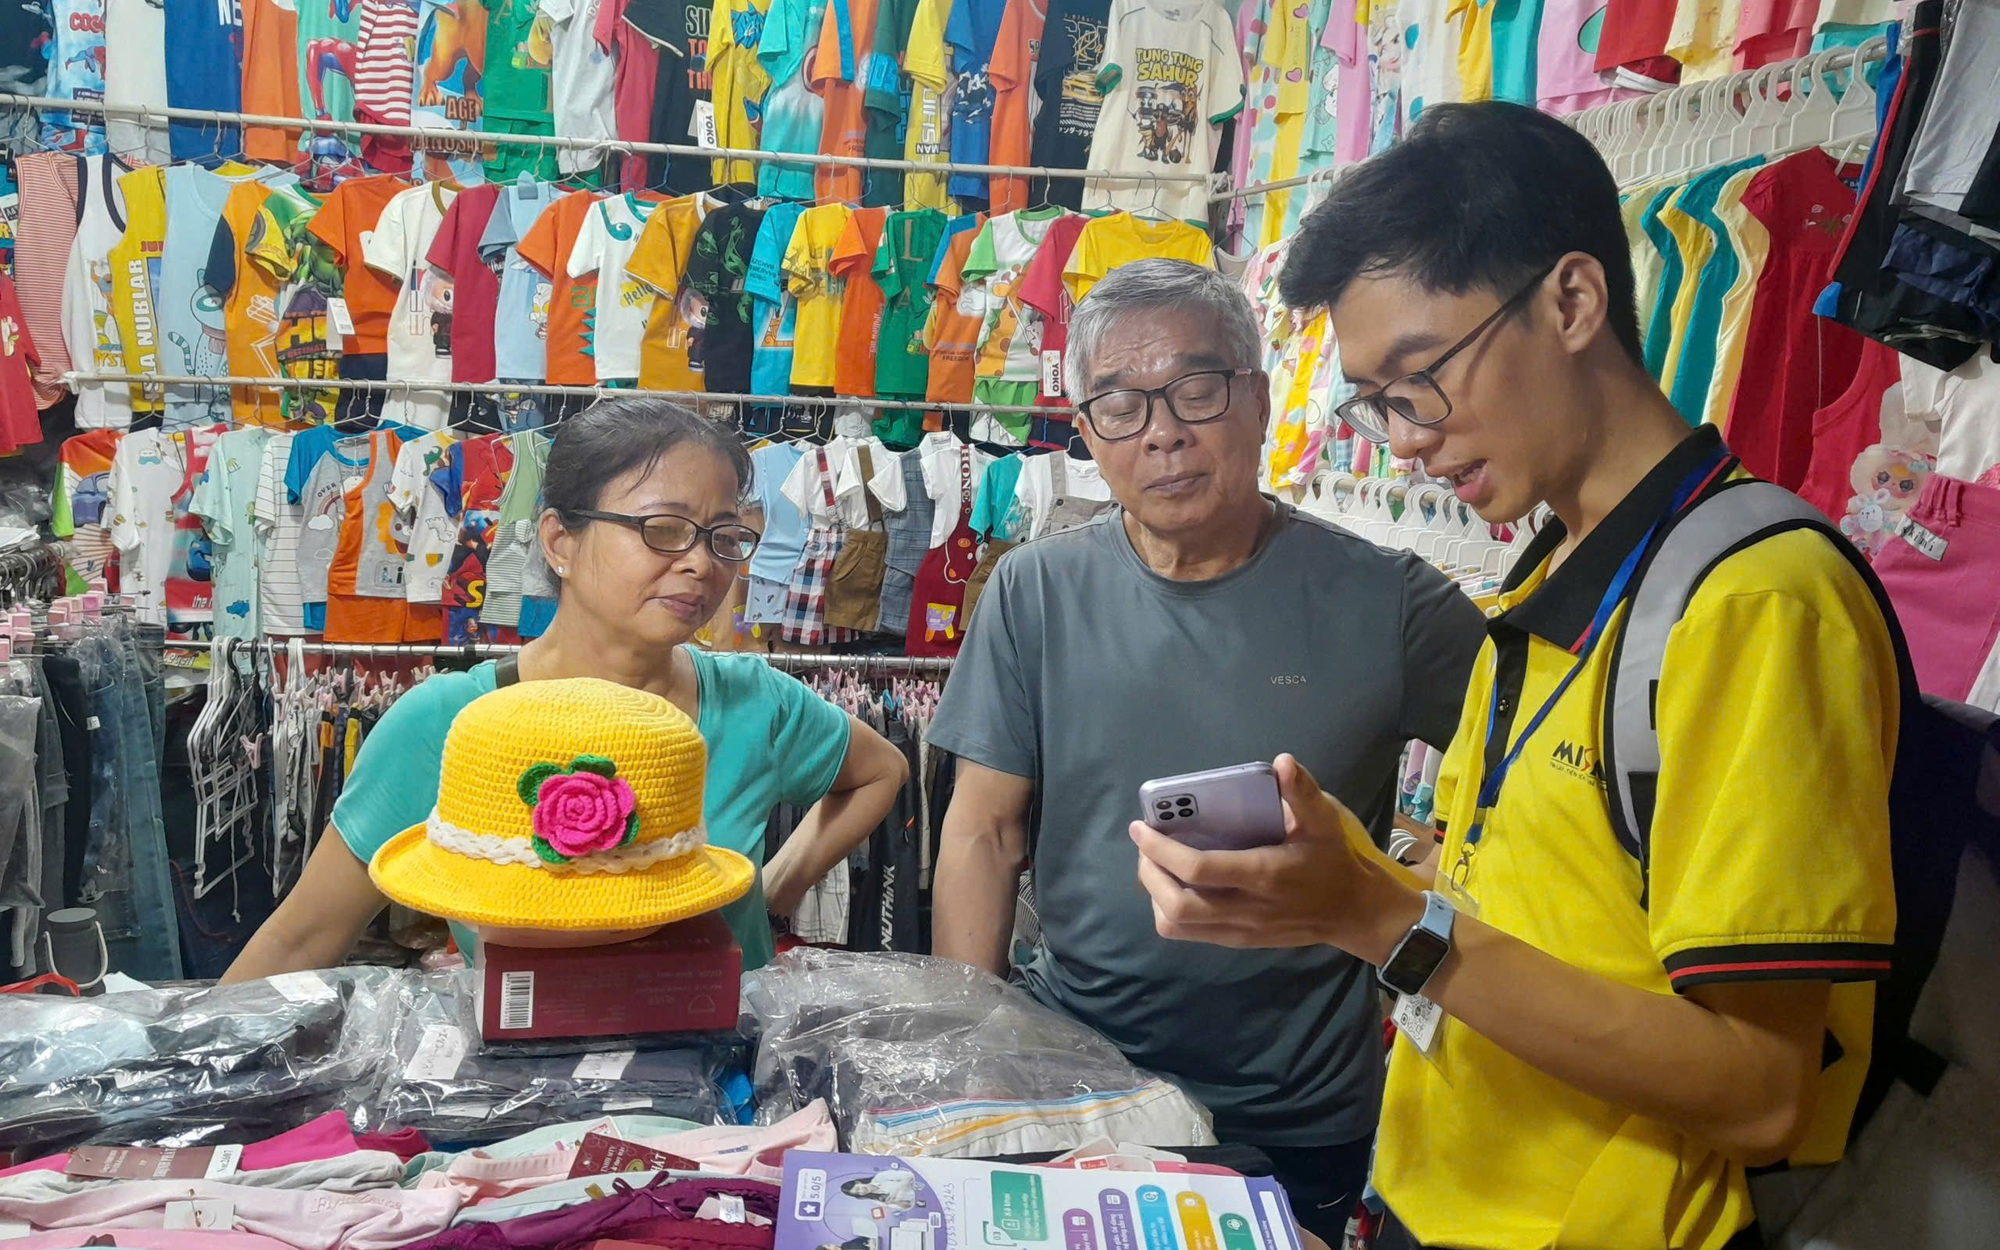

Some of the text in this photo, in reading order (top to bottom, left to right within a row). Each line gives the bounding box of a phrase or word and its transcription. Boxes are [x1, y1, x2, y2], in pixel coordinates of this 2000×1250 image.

[1135, 47, 1204, 72] TUNG TUNG
[1136, 61, 1200, 88] SAHUR
[445, 95, 477, 122] AGE
[705, 114, 715, 146] YOKO
[916, 144, 940, 154] MAN
[128, 258, 154, 347] NUBLAR
[1051, 363, 1059, 393] YOKO
[317, 482, 336, 498] OVER
[1270, 675, 1307, 685] VESCA
[810, 1175, 822, 1199] 5.0/5
[993, 1231, 1001, 1241] 03
